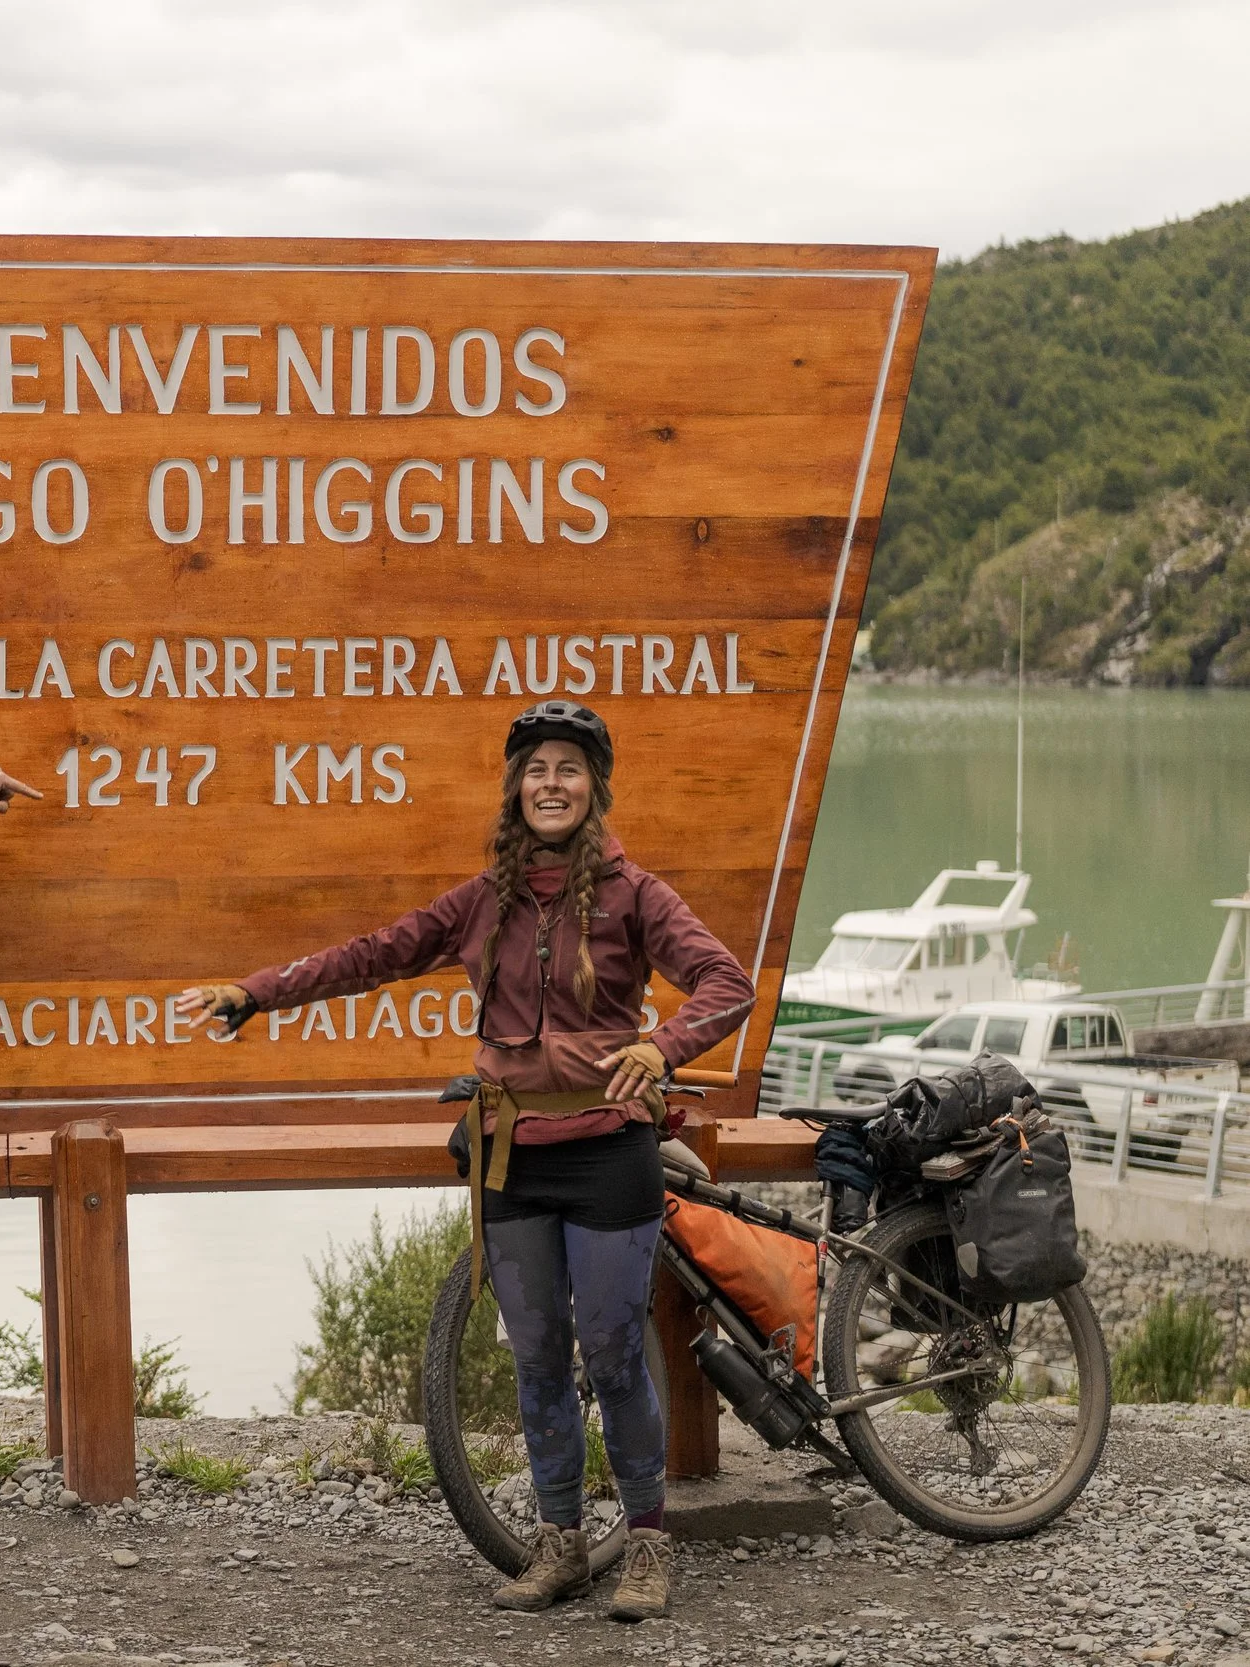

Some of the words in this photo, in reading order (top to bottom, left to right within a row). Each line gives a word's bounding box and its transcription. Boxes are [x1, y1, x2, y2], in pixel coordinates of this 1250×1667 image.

[148, 457, 609, 545] O'HIGGINS
[98, 637, 463, 699] CARRETERA
[484, 634, 755, 697] AUSTRAL
[56, 745, 217, 808] 1247
